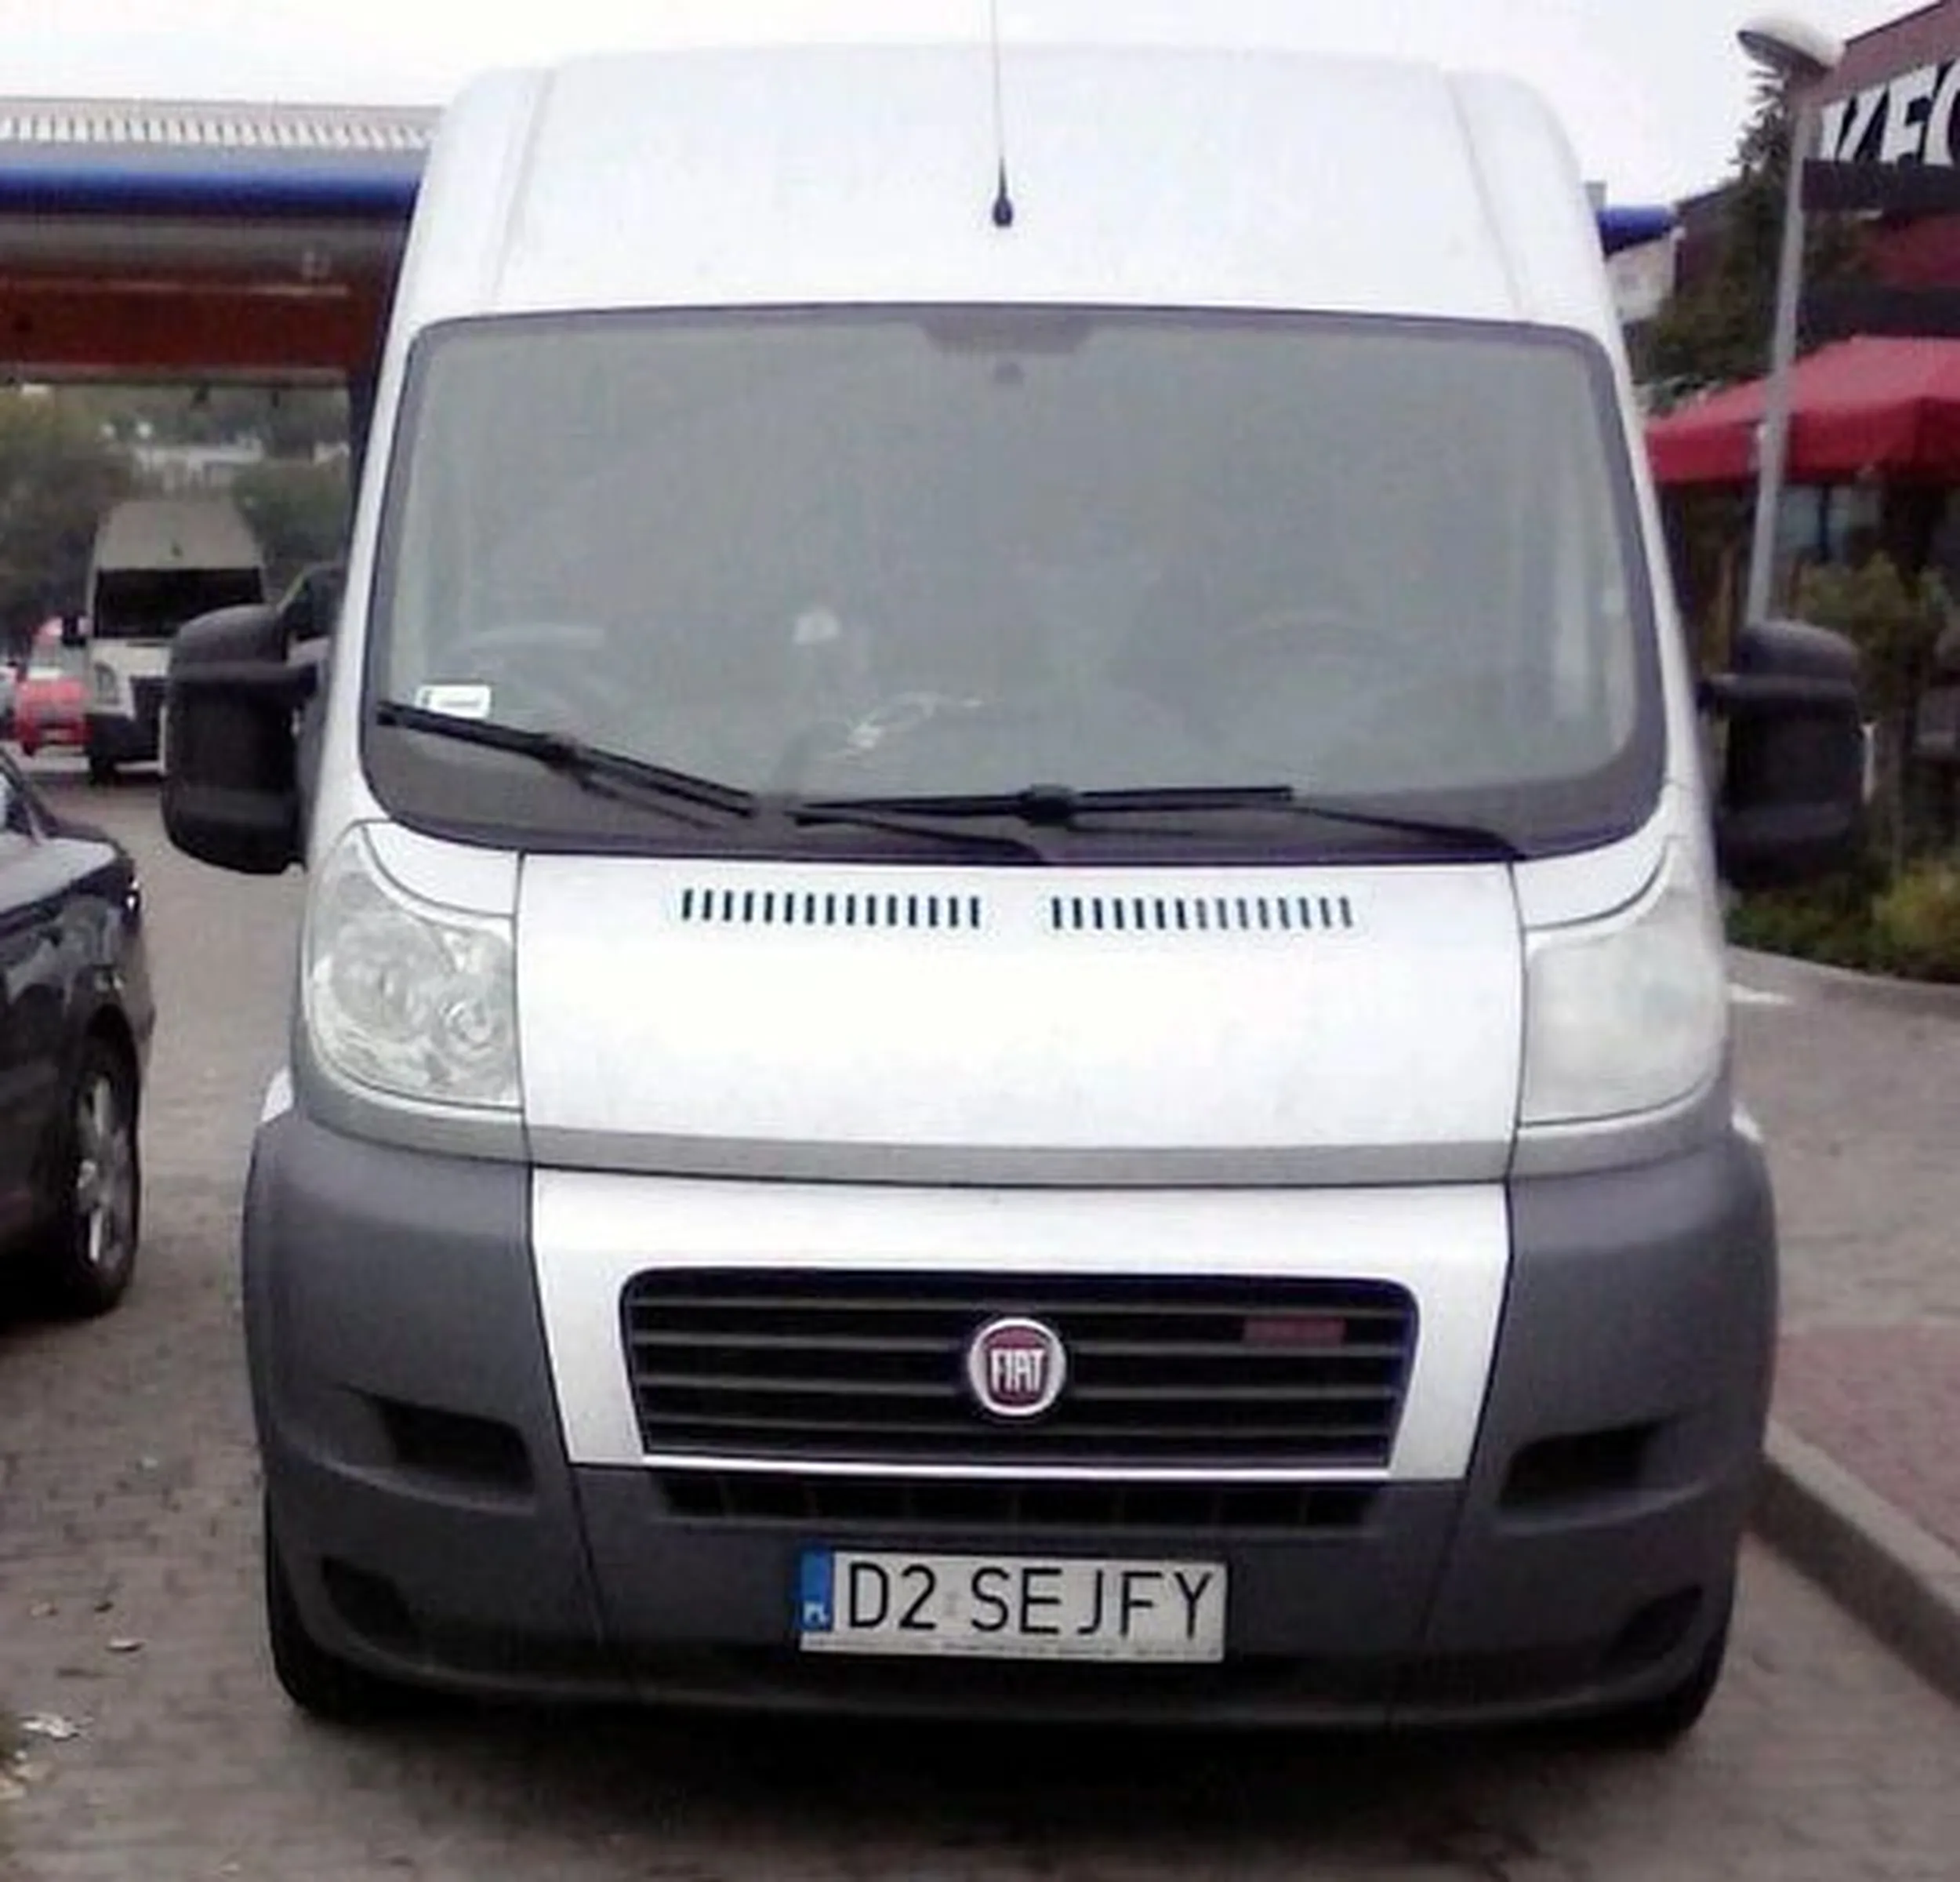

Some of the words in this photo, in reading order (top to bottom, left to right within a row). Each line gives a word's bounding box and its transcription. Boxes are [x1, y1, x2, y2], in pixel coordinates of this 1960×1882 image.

[990, 1348, 1045, 1393] FIAT
[849, 1562, 937, 1630] D2
[970, 1567, 1214, 1640] SEJFY
